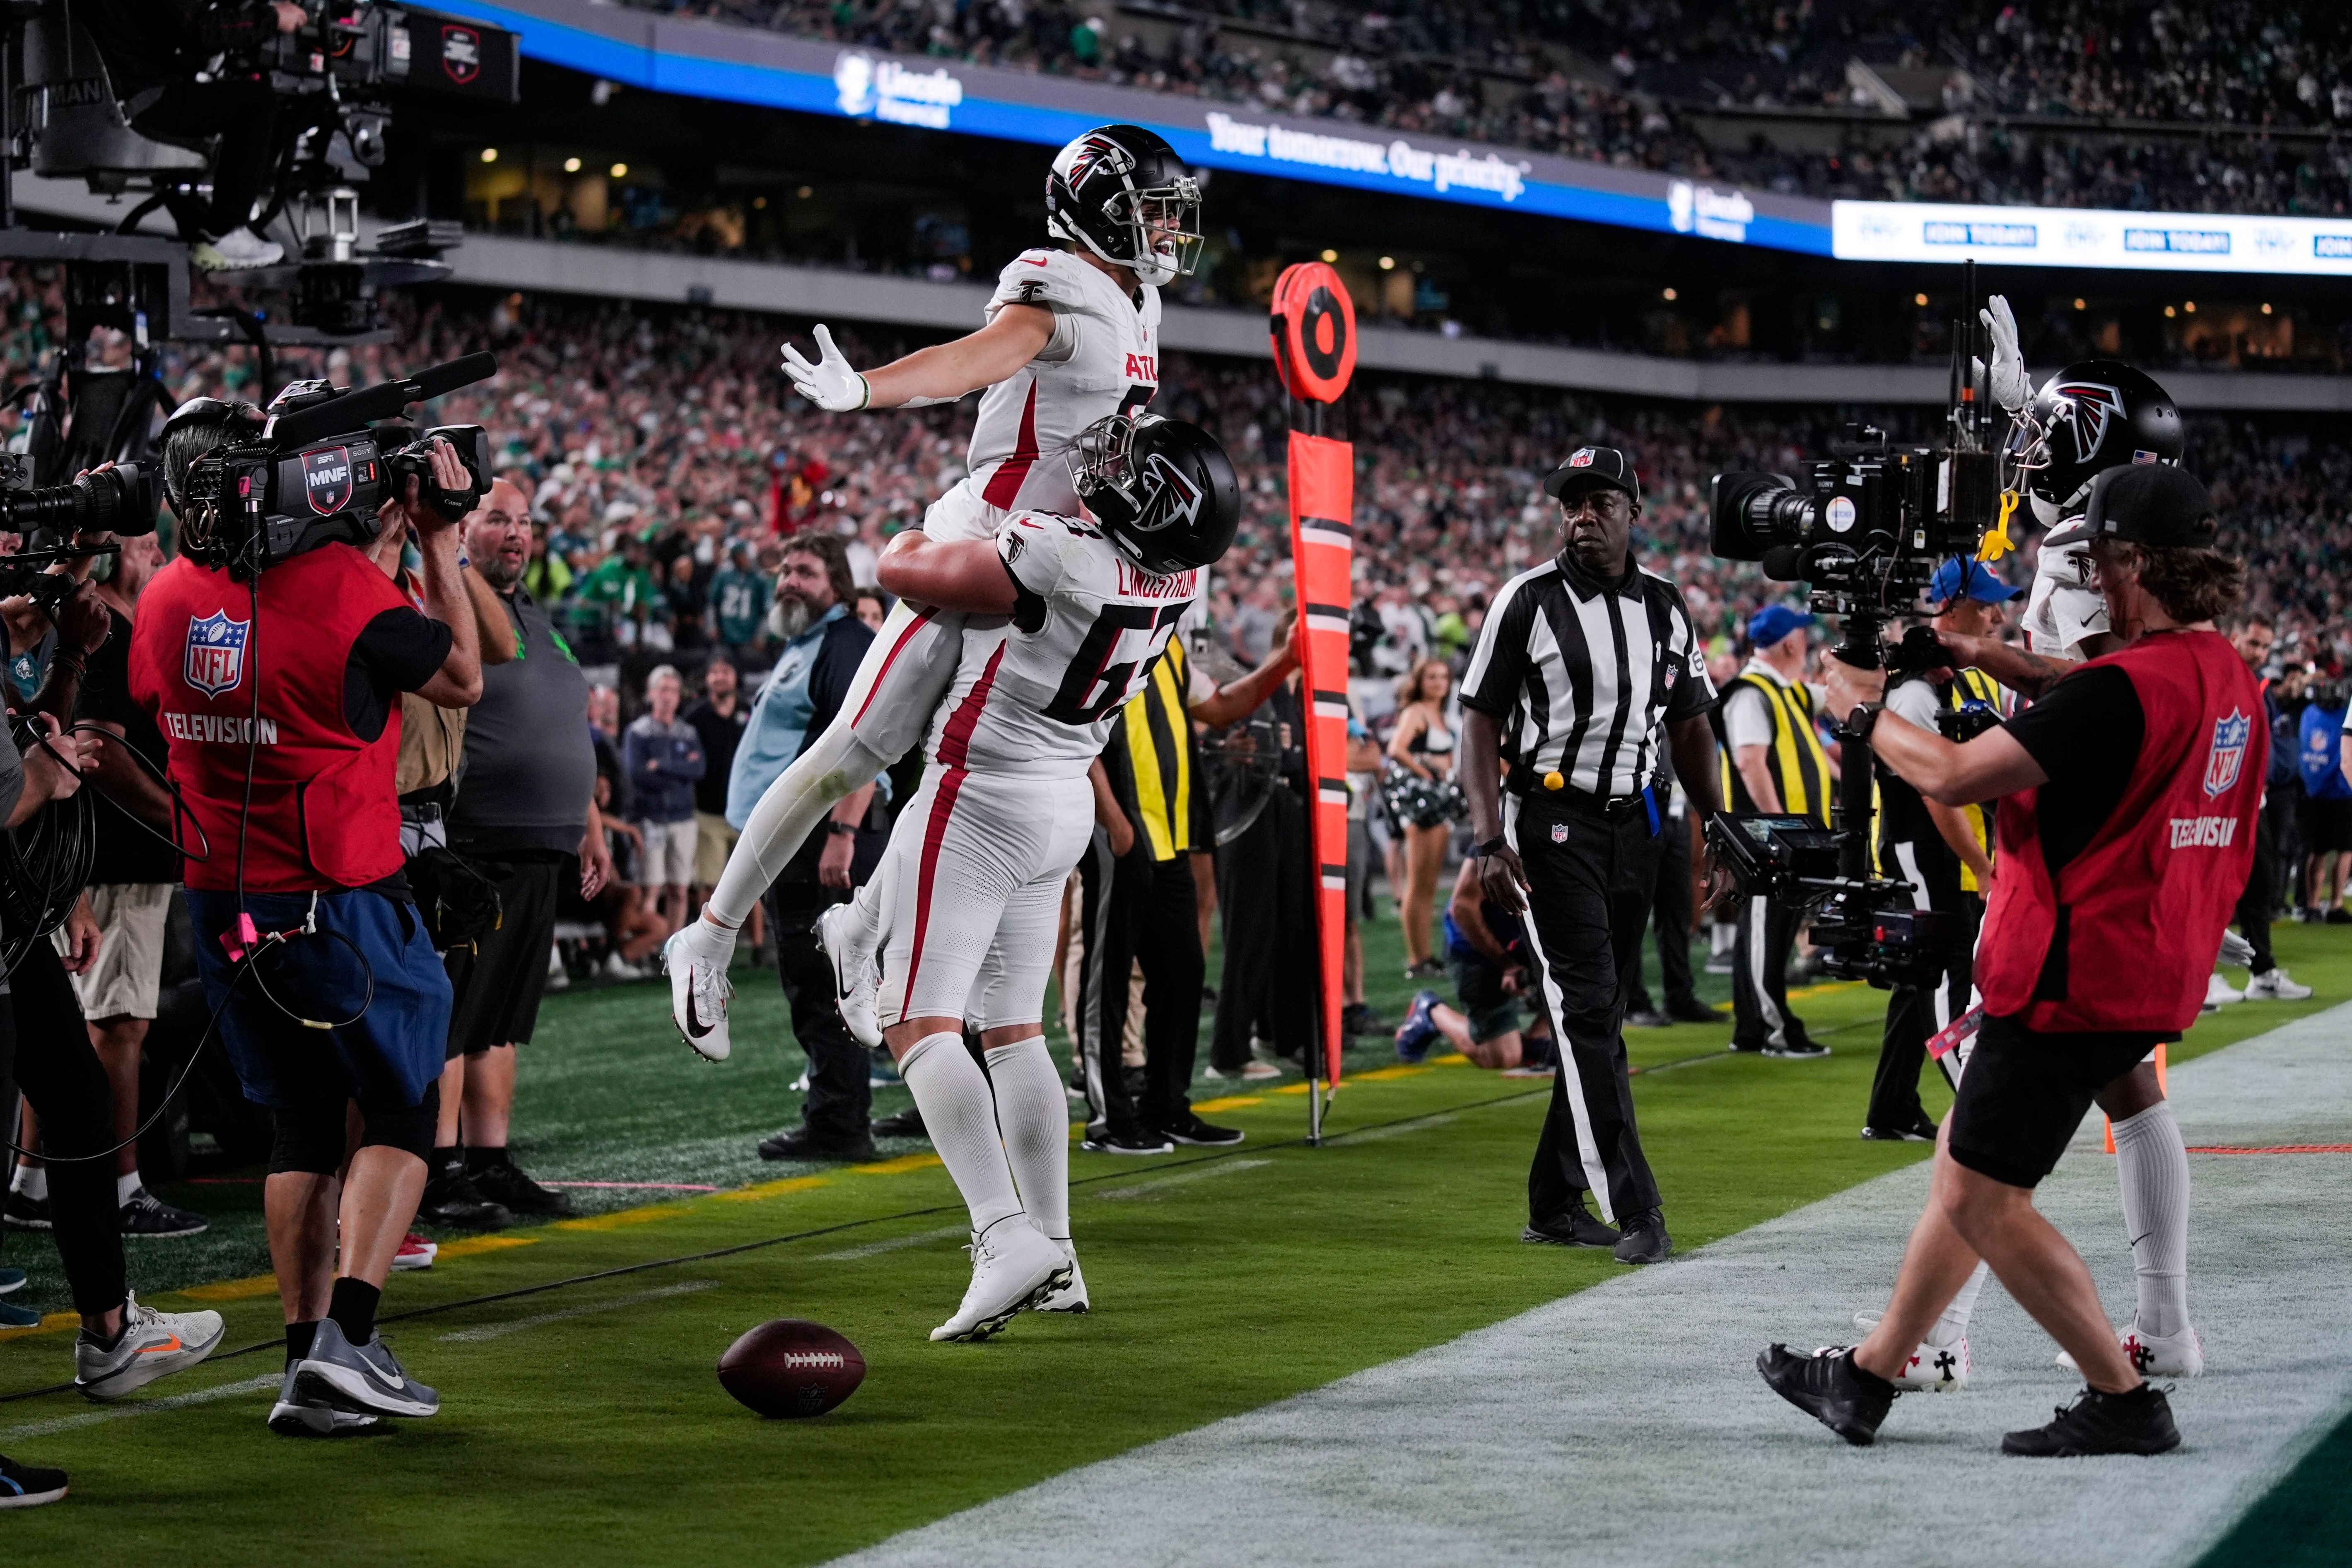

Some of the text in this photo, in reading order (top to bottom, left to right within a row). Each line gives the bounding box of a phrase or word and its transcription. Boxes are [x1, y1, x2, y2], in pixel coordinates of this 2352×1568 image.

[876, 62, 963, 106] Lincoln
[1206, 112, 1266, 156] Your
[1389, 140, 1434, 181] Our
[2126, 230, 2165, 250] JOIN
[318, 455, 334, 464] ESPN
[353, 448, 371, 456] SONY
[309, 466, 347, 487] MNF
[191, 647, 235, 687] NFL
[164, 712, 277, 744] TELEVISION
